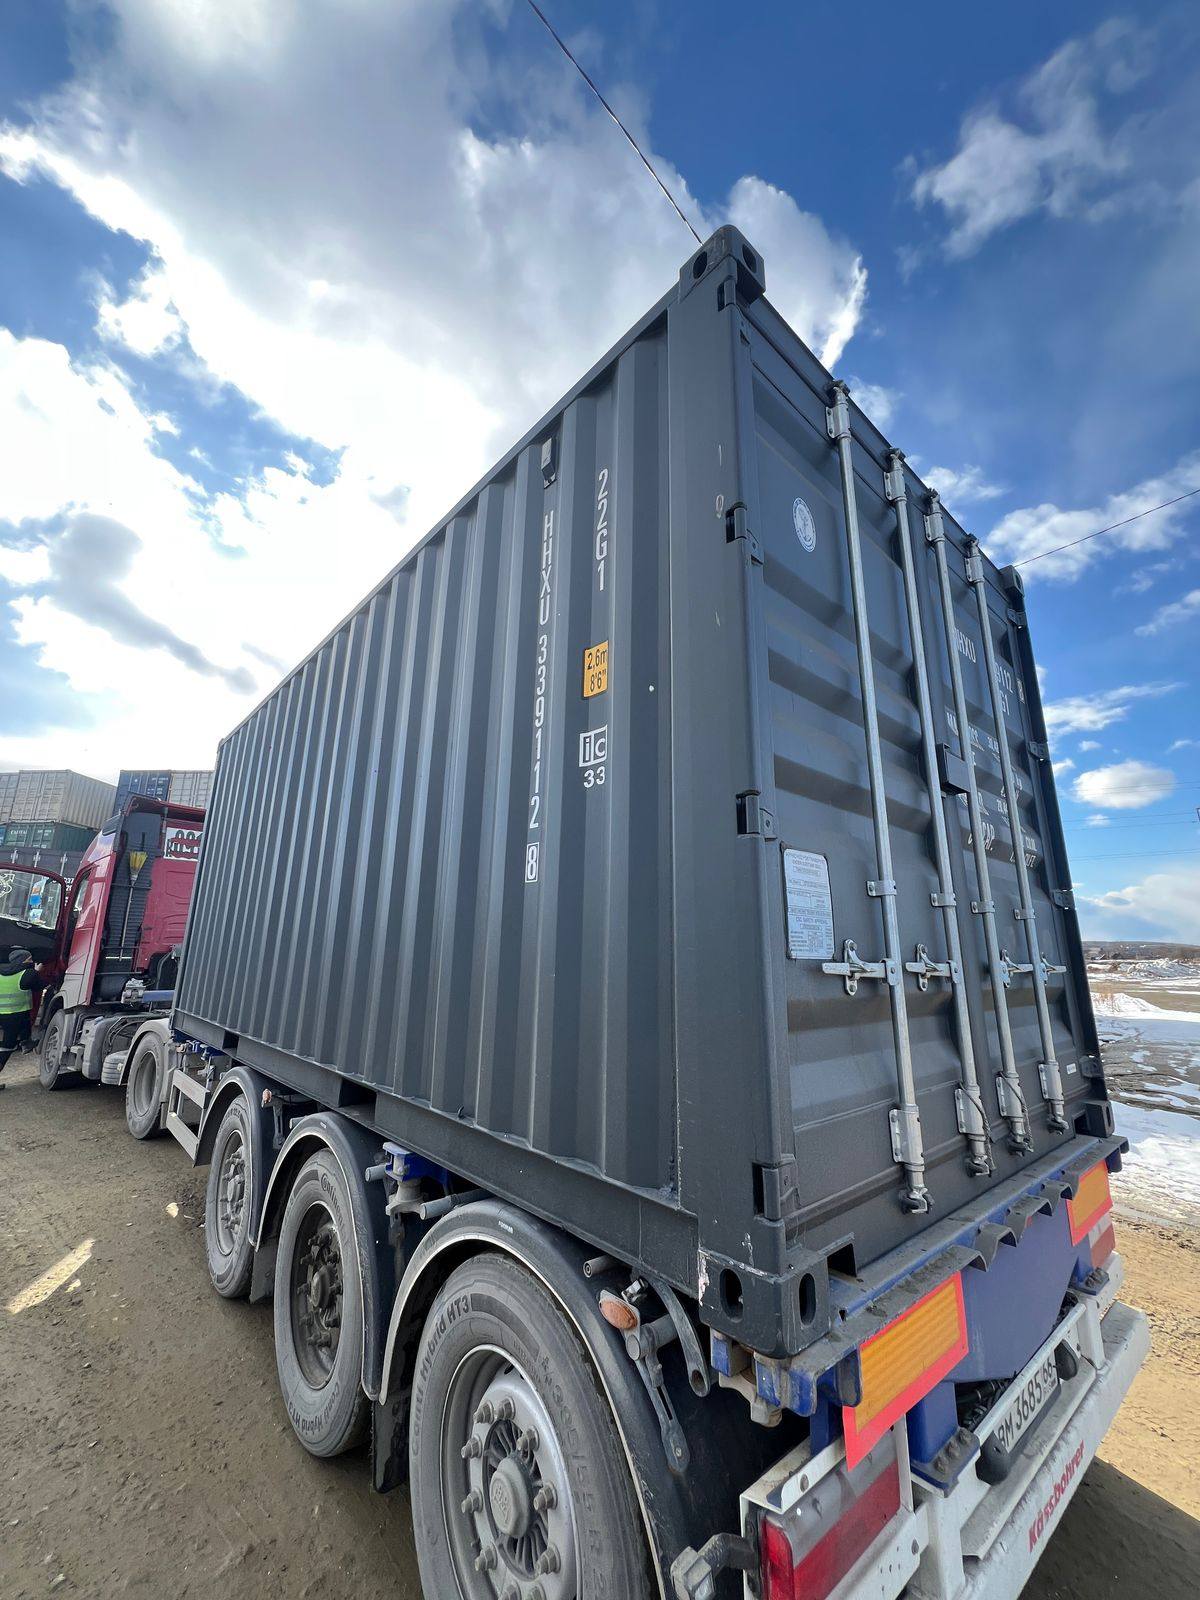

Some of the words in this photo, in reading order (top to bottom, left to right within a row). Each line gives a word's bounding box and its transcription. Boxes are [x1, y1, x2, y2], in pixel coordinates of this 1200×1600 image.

[539, 510, 555, 626] HHXU
[595, 468, 609, 591] 22G1
[529, 634, 549, 829] 339112
[583, 766, 606, 788] 33
[420, 1315, 447, 1382] Hybrid
[446, 1294, 472, 1325] HT3
[1013, 1370, 1042, 1431] 3685
